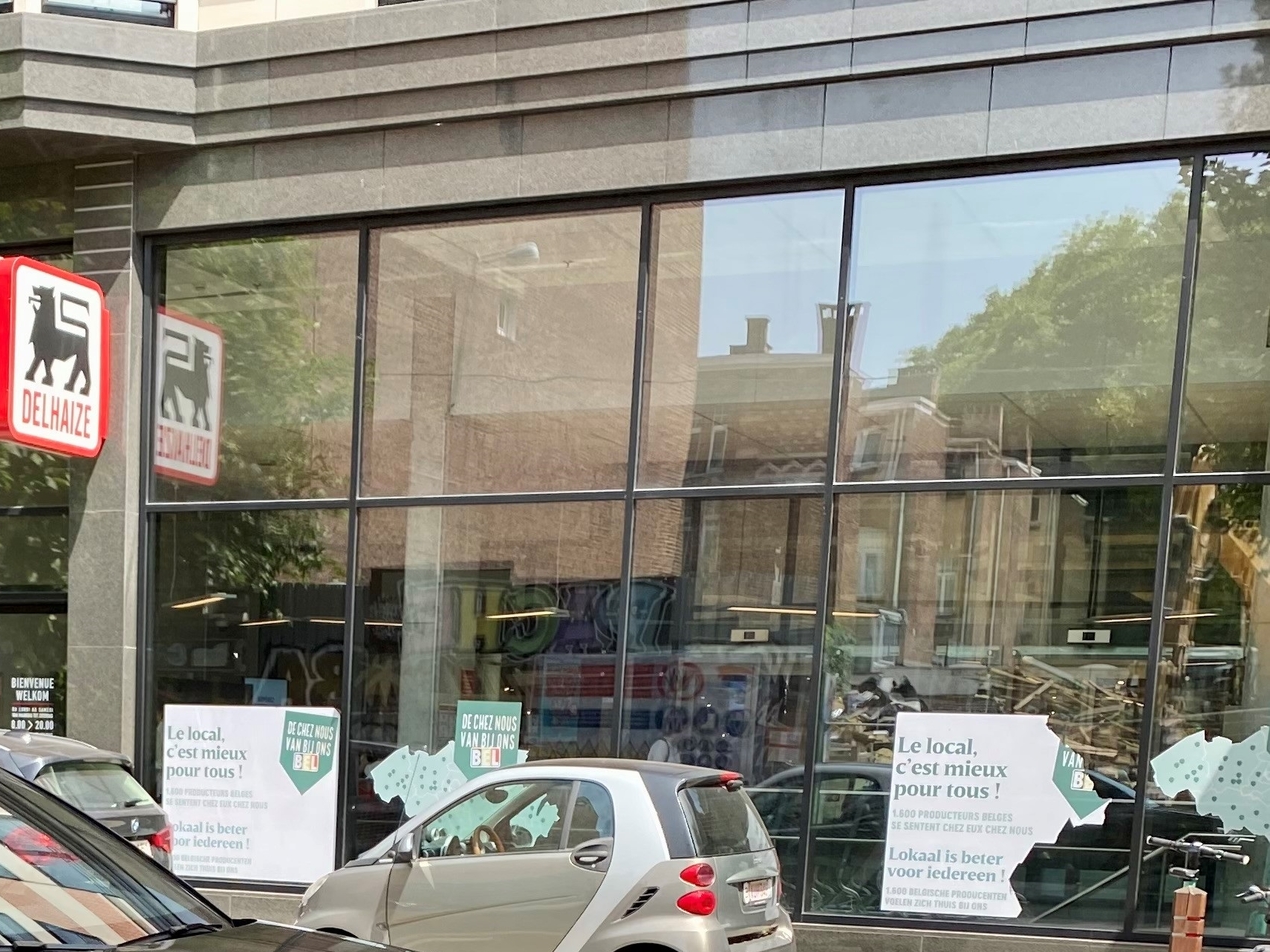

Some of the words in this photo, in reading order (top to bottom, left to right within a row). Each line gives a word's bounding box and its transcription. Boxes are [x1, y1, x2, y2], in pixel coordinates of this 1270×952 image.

[21, 388, 92, 440] DELHAIZE
[10, 677, 54, 689] BIENVENUE
[15, 690, 50, 701] WELKOM
[34, 720, 54, 731] 20.00
[288, 720, 297, 735] DE
[298, 721, 315, 738] CHEZ
[316, 723, 334, 741] NOUS
[462, 714, 472, 729] DE
[473, 714, 494, 730] CHEZ
[495, 715, 518, 731] NOUS
[167, 725, 184, 742] Le
[188, 726, 226, 745] local,
[460, 732, 479, 748] VAN
[480, 732, 495, 748] BIJ
[497, 734, 516, 750] ONS
[166, 745, 197, 760] c'est
[201, 746, 248, 762] mieux
[285, 736, 302, 753] VAN
[302, 738, 314, 755] BIJ
[314, 740, 332, 757] ONS
[898, 736, 922, 755] Le
[926, 736, 978, 758] local,
[293, 753, 320, 772] BEL
[471, 748, 500, 768] BEL
[1062, 750, 1084, 769] VAN
[166, 766, 200, 781] pour
[204, 765, 236, 779] tous
[895, 758, 939, 777] c'est
[944, 760, 1008, 778] mieux
[184, 789, 229, 798] PRODUCTEURS
[230, 790, 253, 799] BELGES
[893, 782, 941, 802] pour
[946, 782, 989, 799] tous
[175, 798, 201, 808] SENTENT
[202, 799, 218, 808] CHEZ
[220, 800, 232, 808] EUX
[233, 800, 250, 810] CHEZ
[250, 801, 268, 810] NOUS
[892, 808, 916, 819] 1.600
[918, 810, 980, 822] PRODUCTEURS
[982, 812, 1014, 822] BELGES
[173, 821, 203, 834] okaal
[206, 822, 216, 834] is
[217, 822, 248, 836] beter
[890, 821, 901, 830] SE
[904, 822, 941, 832] SENTENT
[942, 823, 964, 833] CHEZ
[966, 824, 983, 834] EUX
[985, 824, 1008, 835] CHEZ
[1009, 826, 1034, 836] NOUS
[173, 839, 191, 848] oor
[192, 836, 244, 850] iedereen
[888, 846, 942, 863] Lokaal
[945, 849, 958, 864] is
[961, 850, 1004, 866] beter
[887, 866, 924, 879] voor
[927, 866, 996, 883] iedereen
[886, 886, 907, 896] 1.600
[908, 888, 950, 898] BELGISCHE
[951, 890, 1008, 901] PRODUCENTEN
[885, 897, 912, 908] VOELEN
[914, 898, 932, 908] ZICH
[934, 899, 957, 909] THUIS
[958, 900, 970, 910] BIJ
[971, 902, 988, 911] ONS
